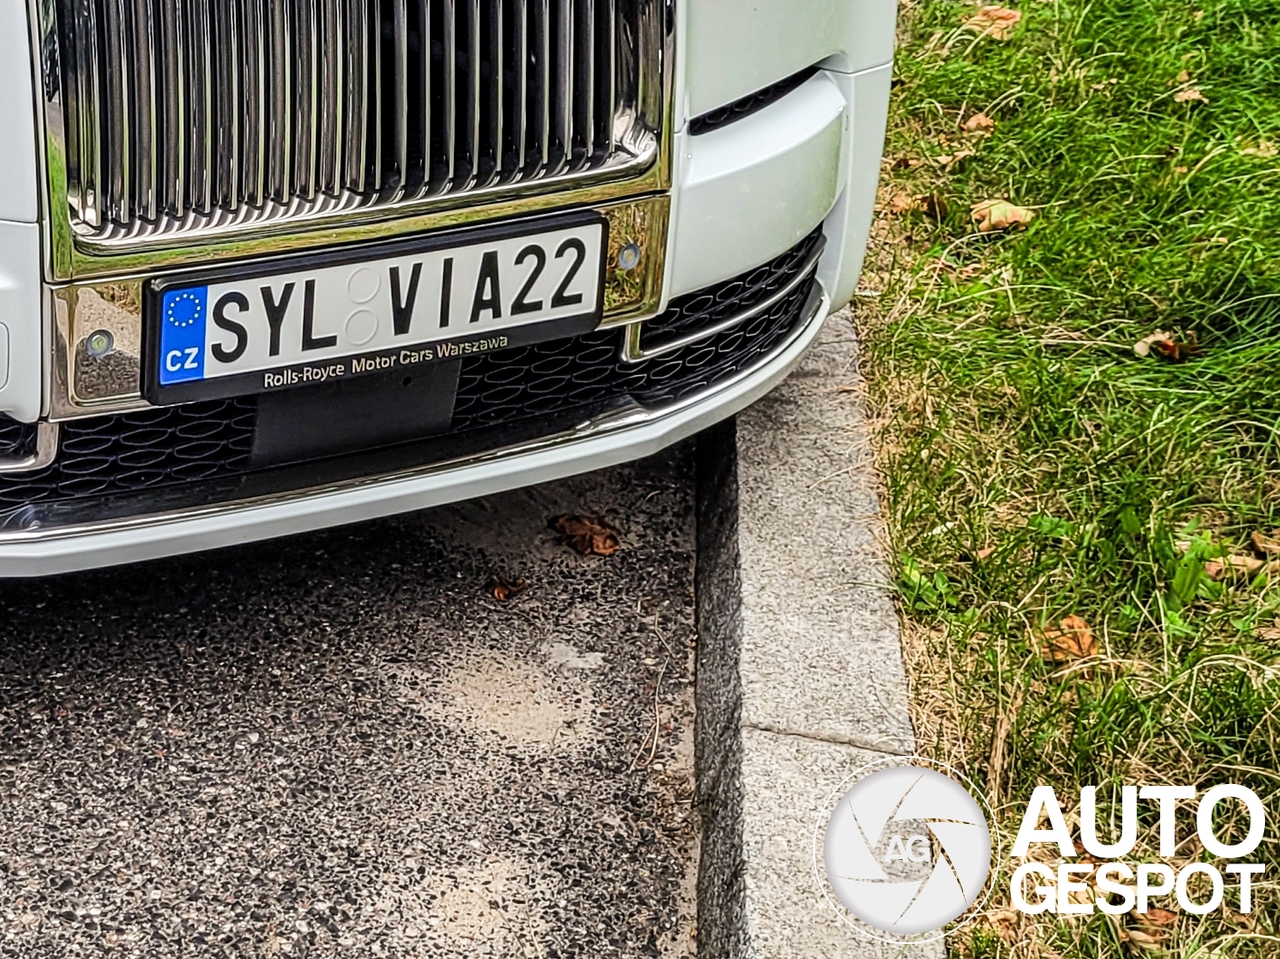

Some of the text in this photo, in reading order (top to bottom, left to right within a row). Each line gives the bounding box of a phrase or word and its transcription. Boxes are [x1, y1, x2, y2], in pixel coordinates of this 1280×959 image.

[210, 278, 338, 364] SYL
[165, 346, 199, 373] CZ
[264, 334, 509, 389] Rolls-Royce Motor Cars Warszawa
